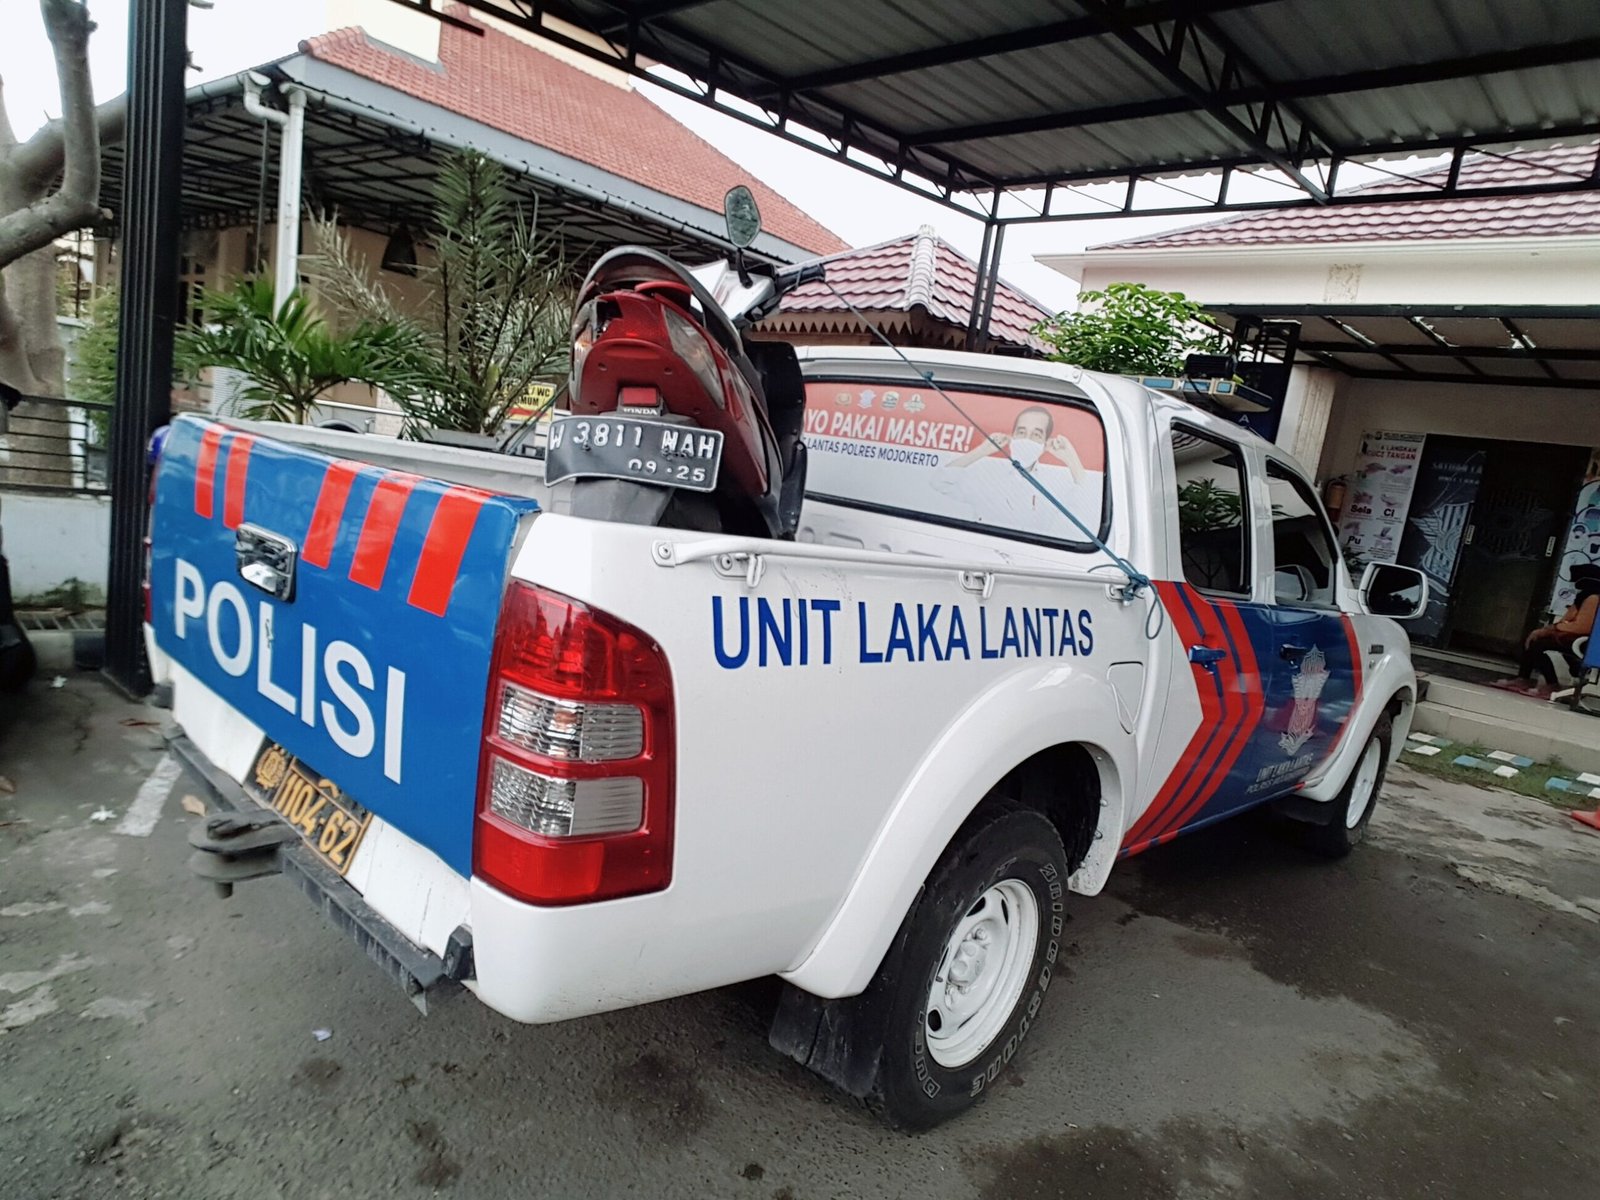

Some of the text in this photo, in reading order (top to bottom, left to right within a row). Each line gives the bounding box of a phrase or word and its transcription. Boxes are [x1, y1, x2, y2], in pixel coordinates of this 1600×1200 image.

[549, 421, 715, 459] W 3811 NAH
[804, 408, 974, 452] YO PAKAI MASKER!
[807, 437, 939, 467] LANTAS POLRES MOJOKERTO
[1386, 451, 1416, 459] TANGAN
[711, 595, 1094, 670] UNIT LAKA LANTAS
[174, 557, 406, 785] POLISI
